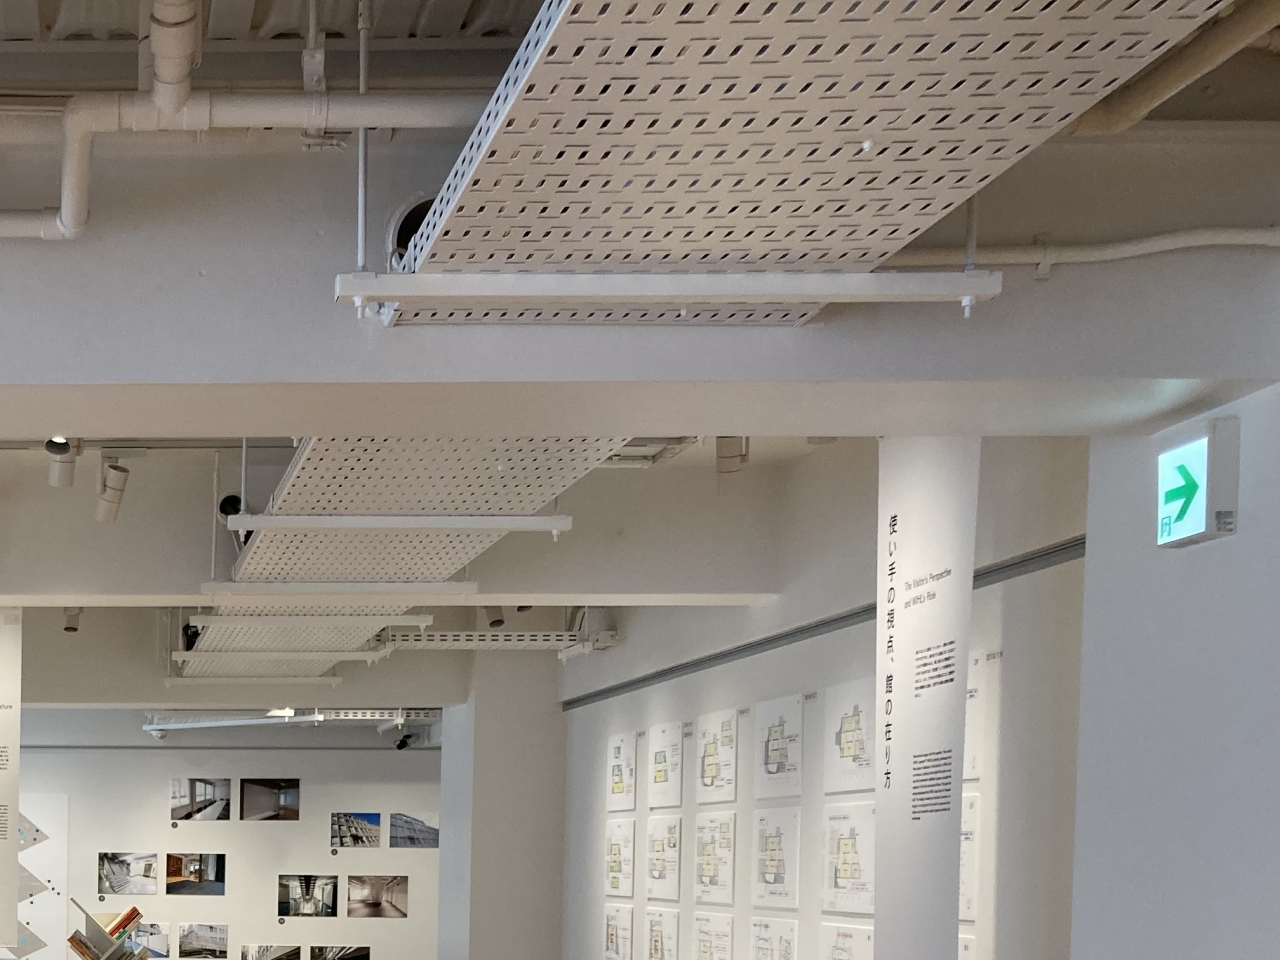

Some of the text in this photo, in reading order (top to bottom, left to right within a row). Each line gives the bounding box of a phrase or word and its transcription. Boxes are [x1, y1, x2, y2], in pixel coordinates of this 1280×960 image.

[884, 513, 899, 789] 使い手の視点、館の在り方
